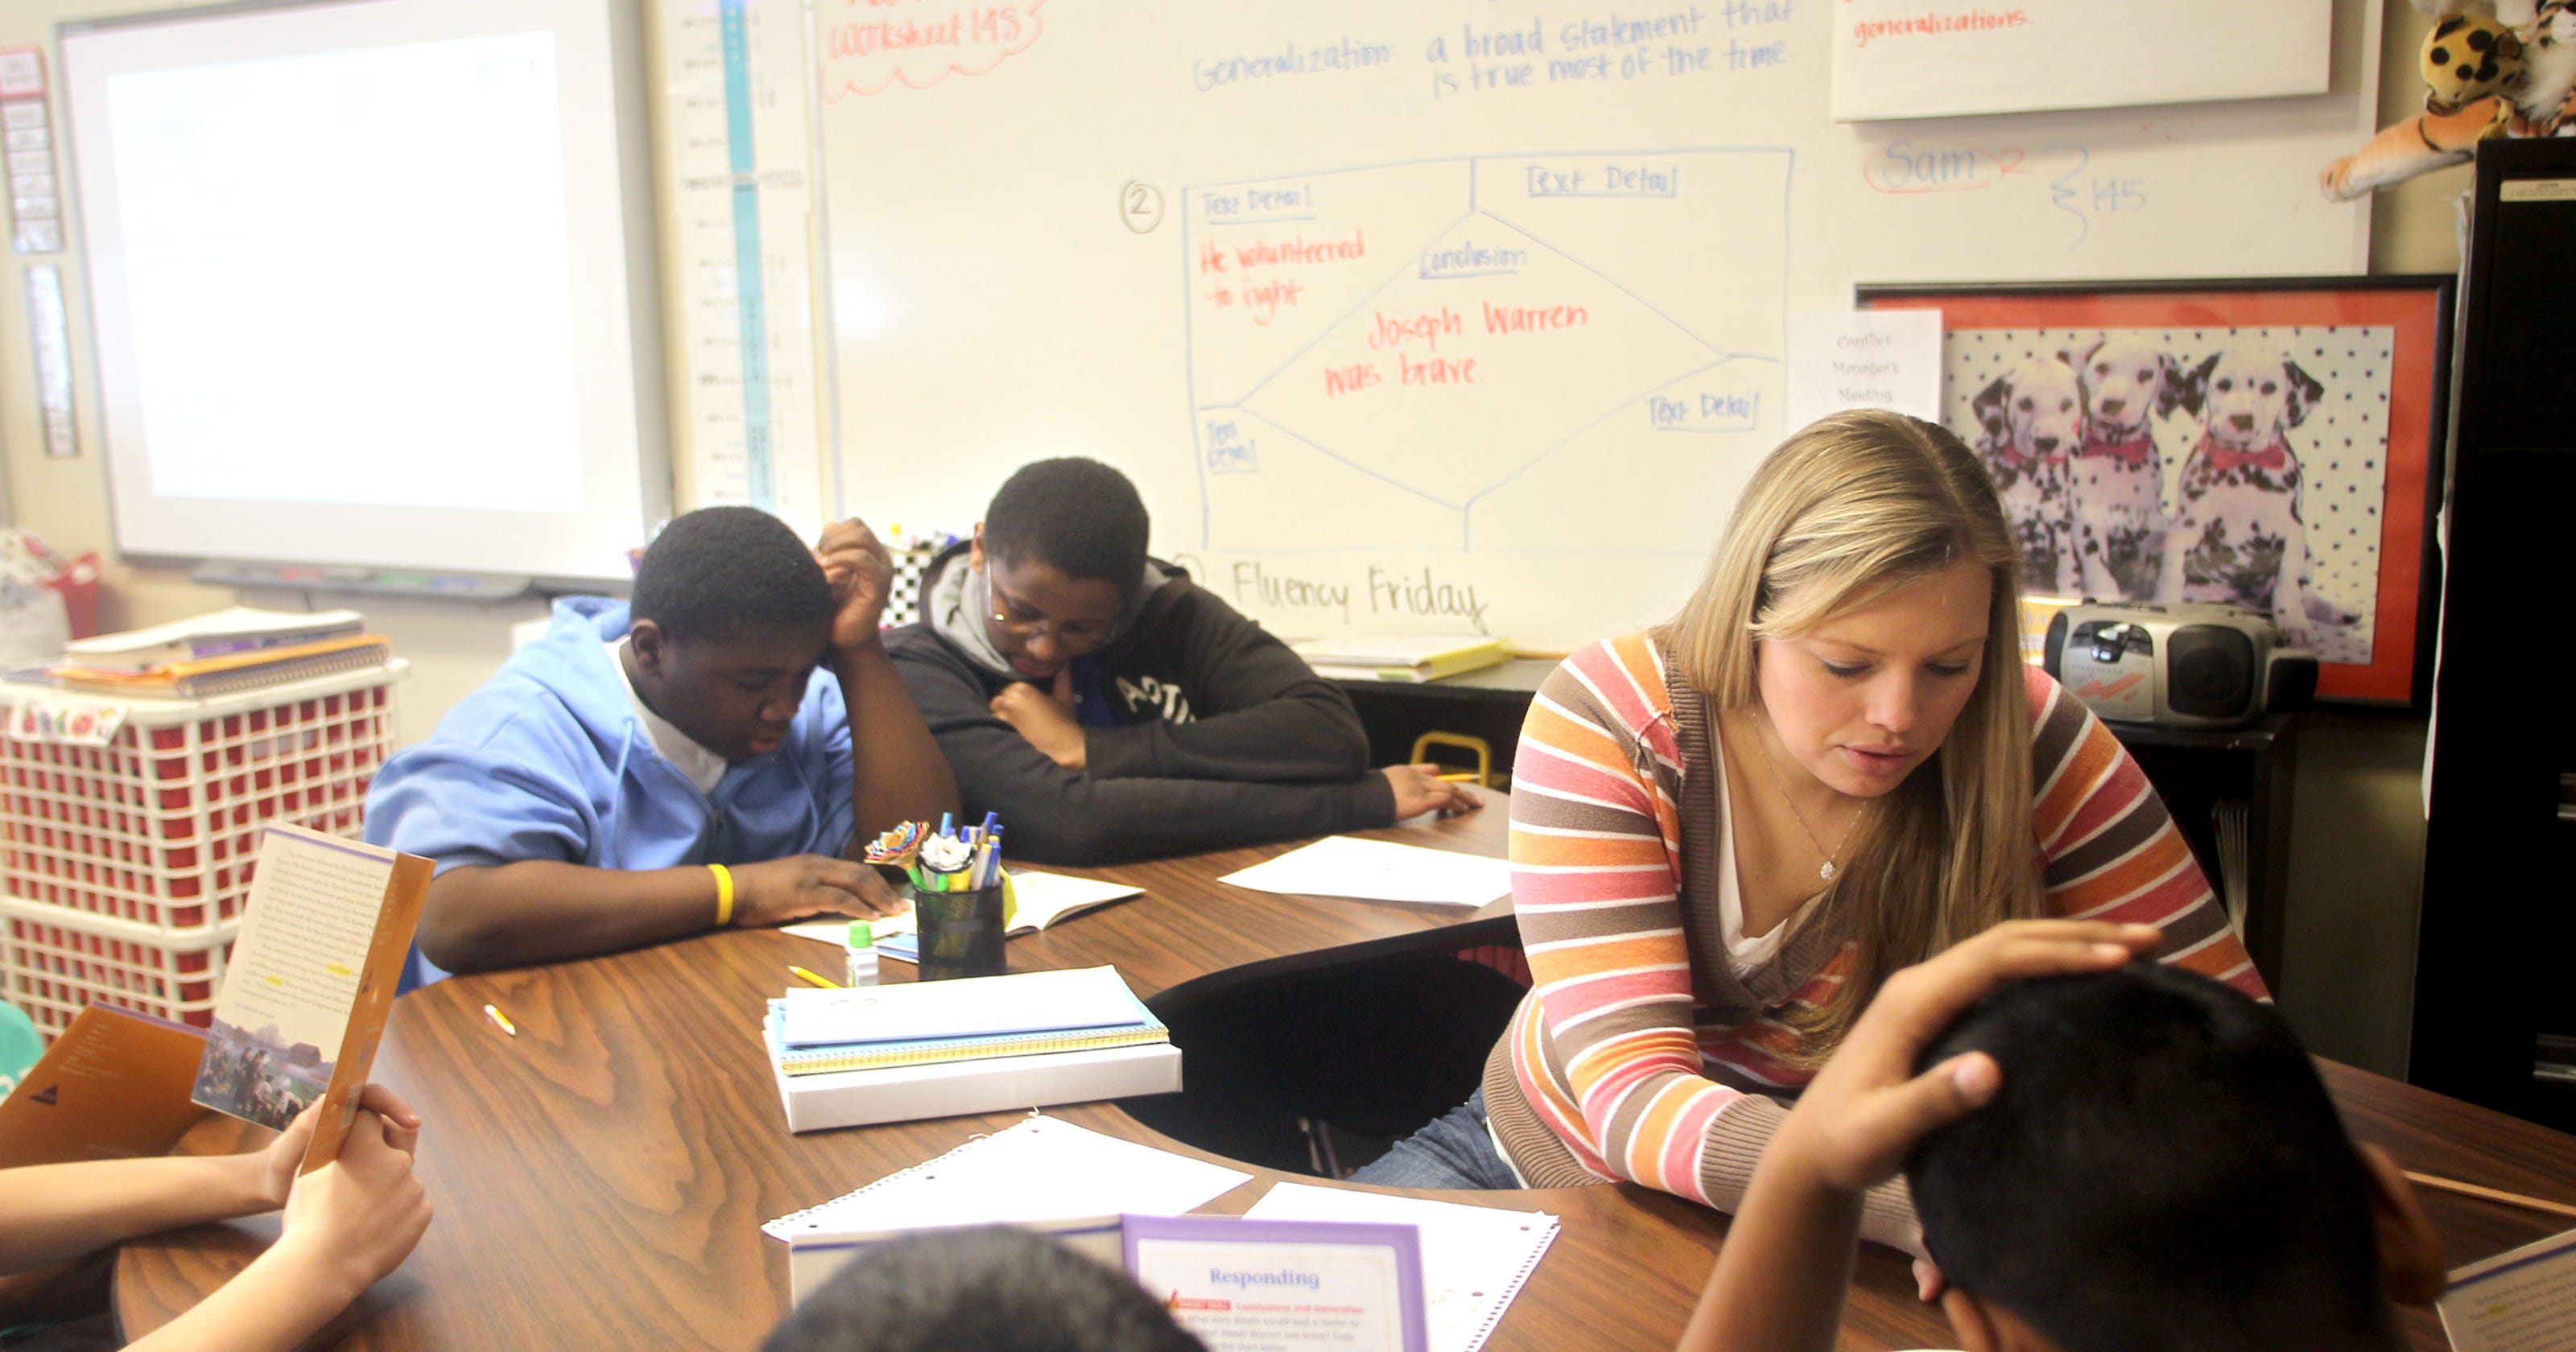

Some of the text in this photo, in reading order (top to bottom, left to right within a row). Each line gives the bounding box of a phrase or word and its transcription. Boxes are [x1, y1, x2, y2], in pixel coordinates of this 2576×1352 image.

[1426, 36, 1447, 63] a
[1464, 20, 1544, 59] broad
[1721, 0, 1794, 28] that
[1434, 39, 1789, 101] is true most of the time
[1527, 165, 1678, 196] Text Detail
[1883, 139, 1975, 188] Sam
[1200, 229, 1364, 274] He volunteered
[1419, 241, 1526, 278] Conclusion
[1206, 278, 1306, 327] to fight
[1368, 300, 1587, 353] Joseph Warren
[1325, 365, 1381, 398] was
[1645, 395, 1690, 426] Text
[1232, 563, 1490, 636] Fluency Friday
[1210, 1268, 1321, 1290] Responding
